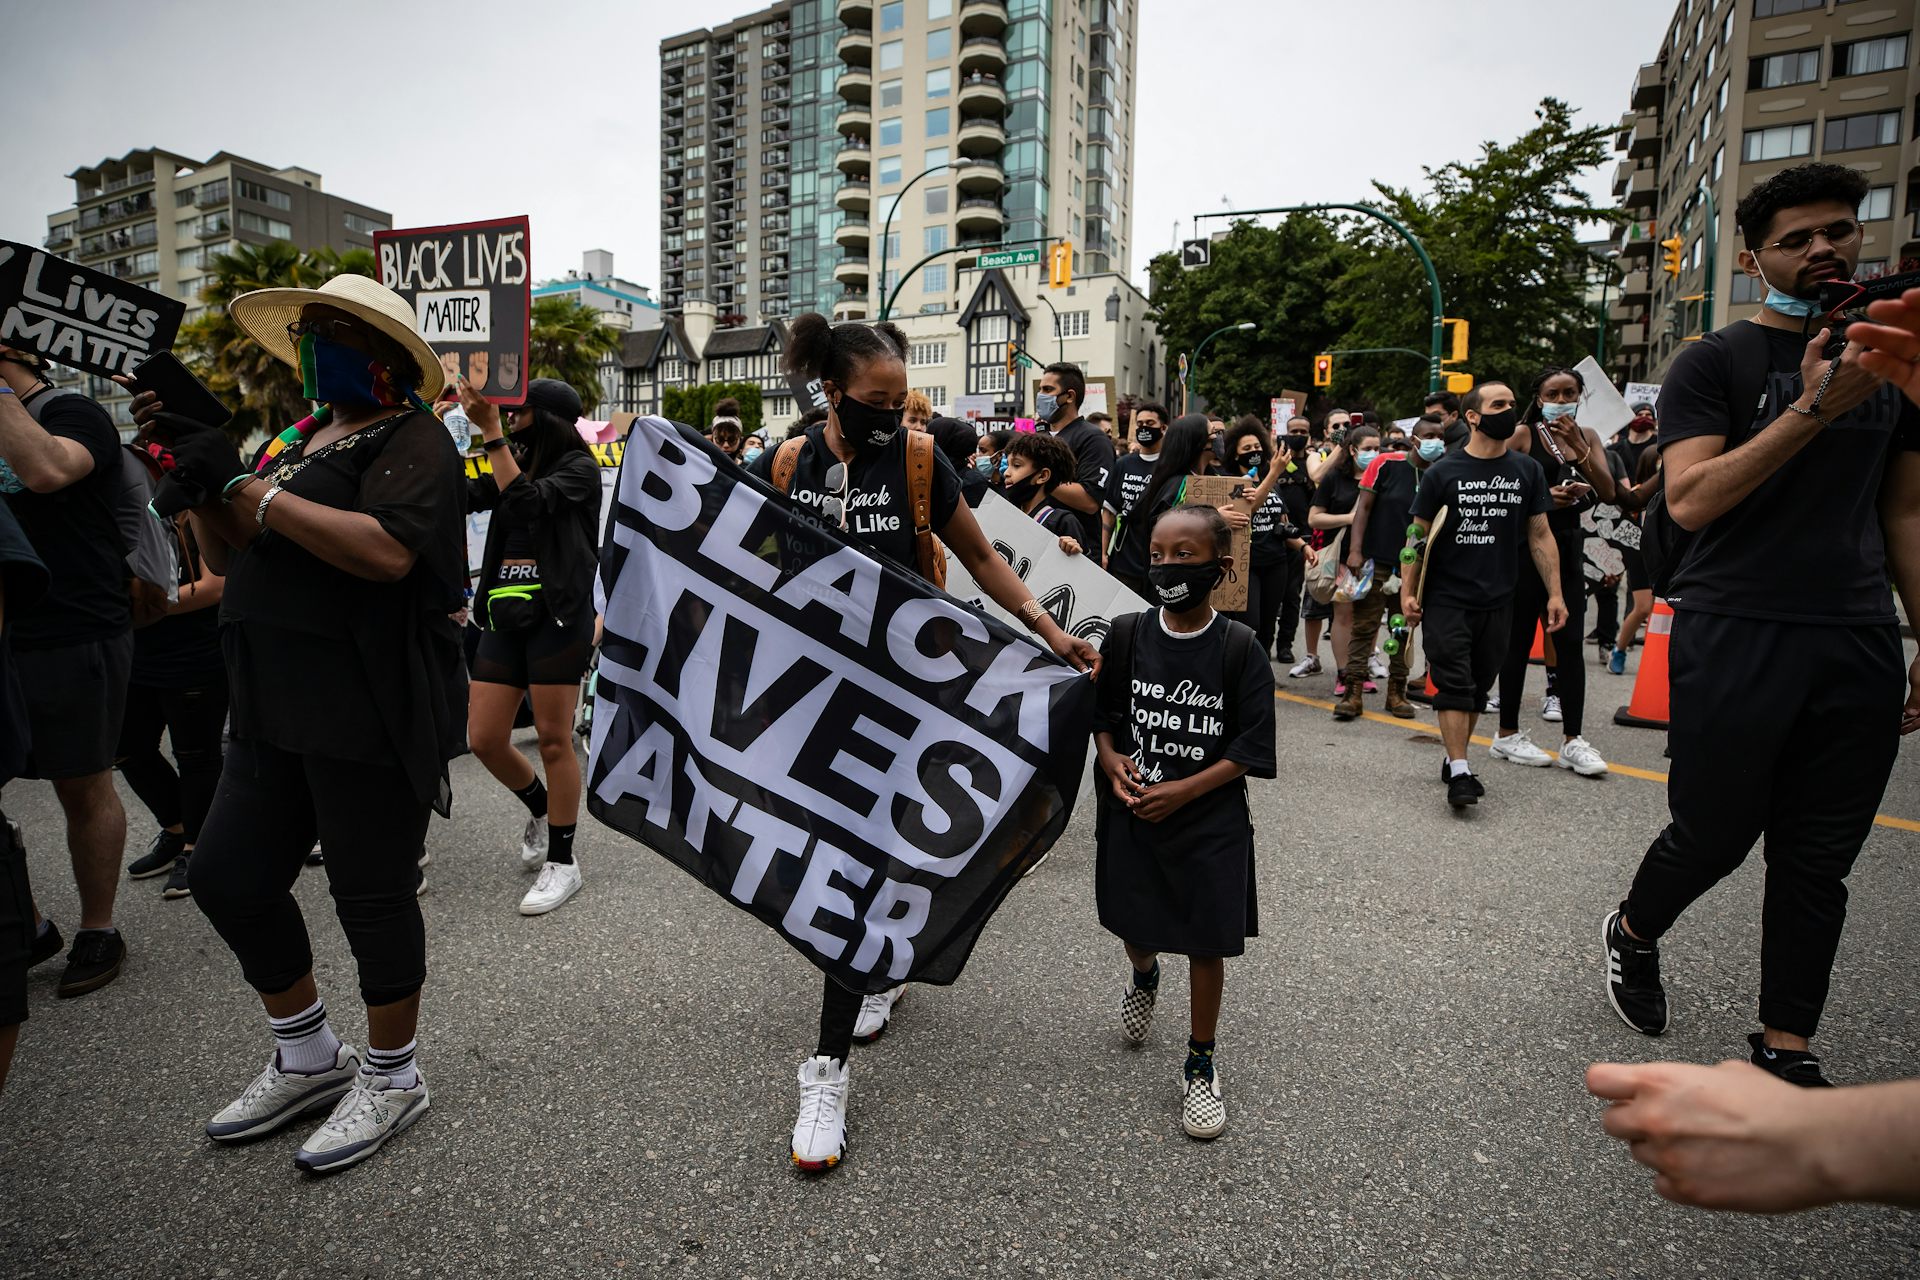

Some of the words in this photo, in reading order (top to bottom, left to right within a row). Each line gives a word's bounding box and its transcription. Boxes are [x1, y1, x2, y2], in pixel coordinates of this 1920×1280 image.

[380, 241, 453, 290] BLACK
[463, 231, 527, 286] LIVES
[1016, 252, 1036, 263] Ave
[1, 306, 151, 376] MATTE
[1458, 481, 1488, 491] Love
[1488, 475, 1521, 490] Black
[1458, 492, 1498, 505] People
[1499, 492, 1523, 504] Like
[1458, 507, 1479, 517] You
[1482, 506, 1508, 517] Love
[855, 513, 900, 534] Like
[1457, 518, 1489, 532] Black
[1455, 534, 1496, 544] Culture
[618, 415, 1085, 754] BLACK
[1131, 679, 1165, 699] ove
[1150, 734, 1205, 761] Love
